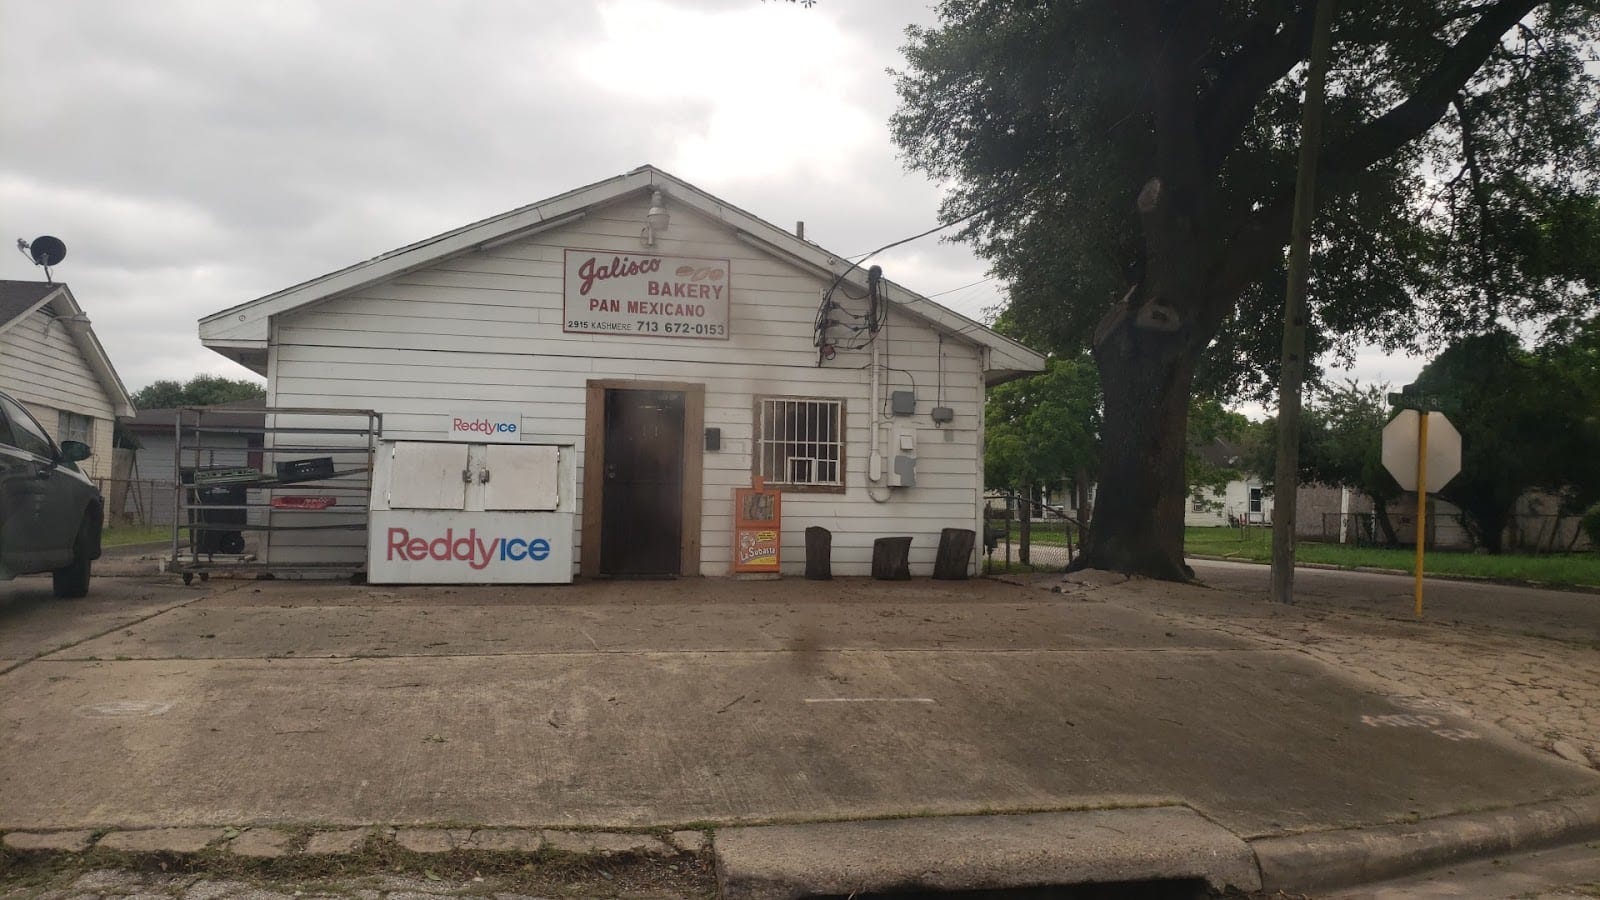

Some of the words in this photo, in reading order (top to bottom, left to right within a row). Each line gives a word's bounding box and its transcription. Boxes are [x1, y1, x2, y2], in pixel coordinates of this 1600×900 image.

[648, 281, 723, 299] BAKERY
[590, 299, 620, 312] PAN
[627, 300, 705, 317] MEXICANO
[568, 320, 589, 329] 2915
[591, 321, 632, 331] KASHMERE
[637, 321, 658, 332] 713
[664, 323, 725, 335] 672-0153
